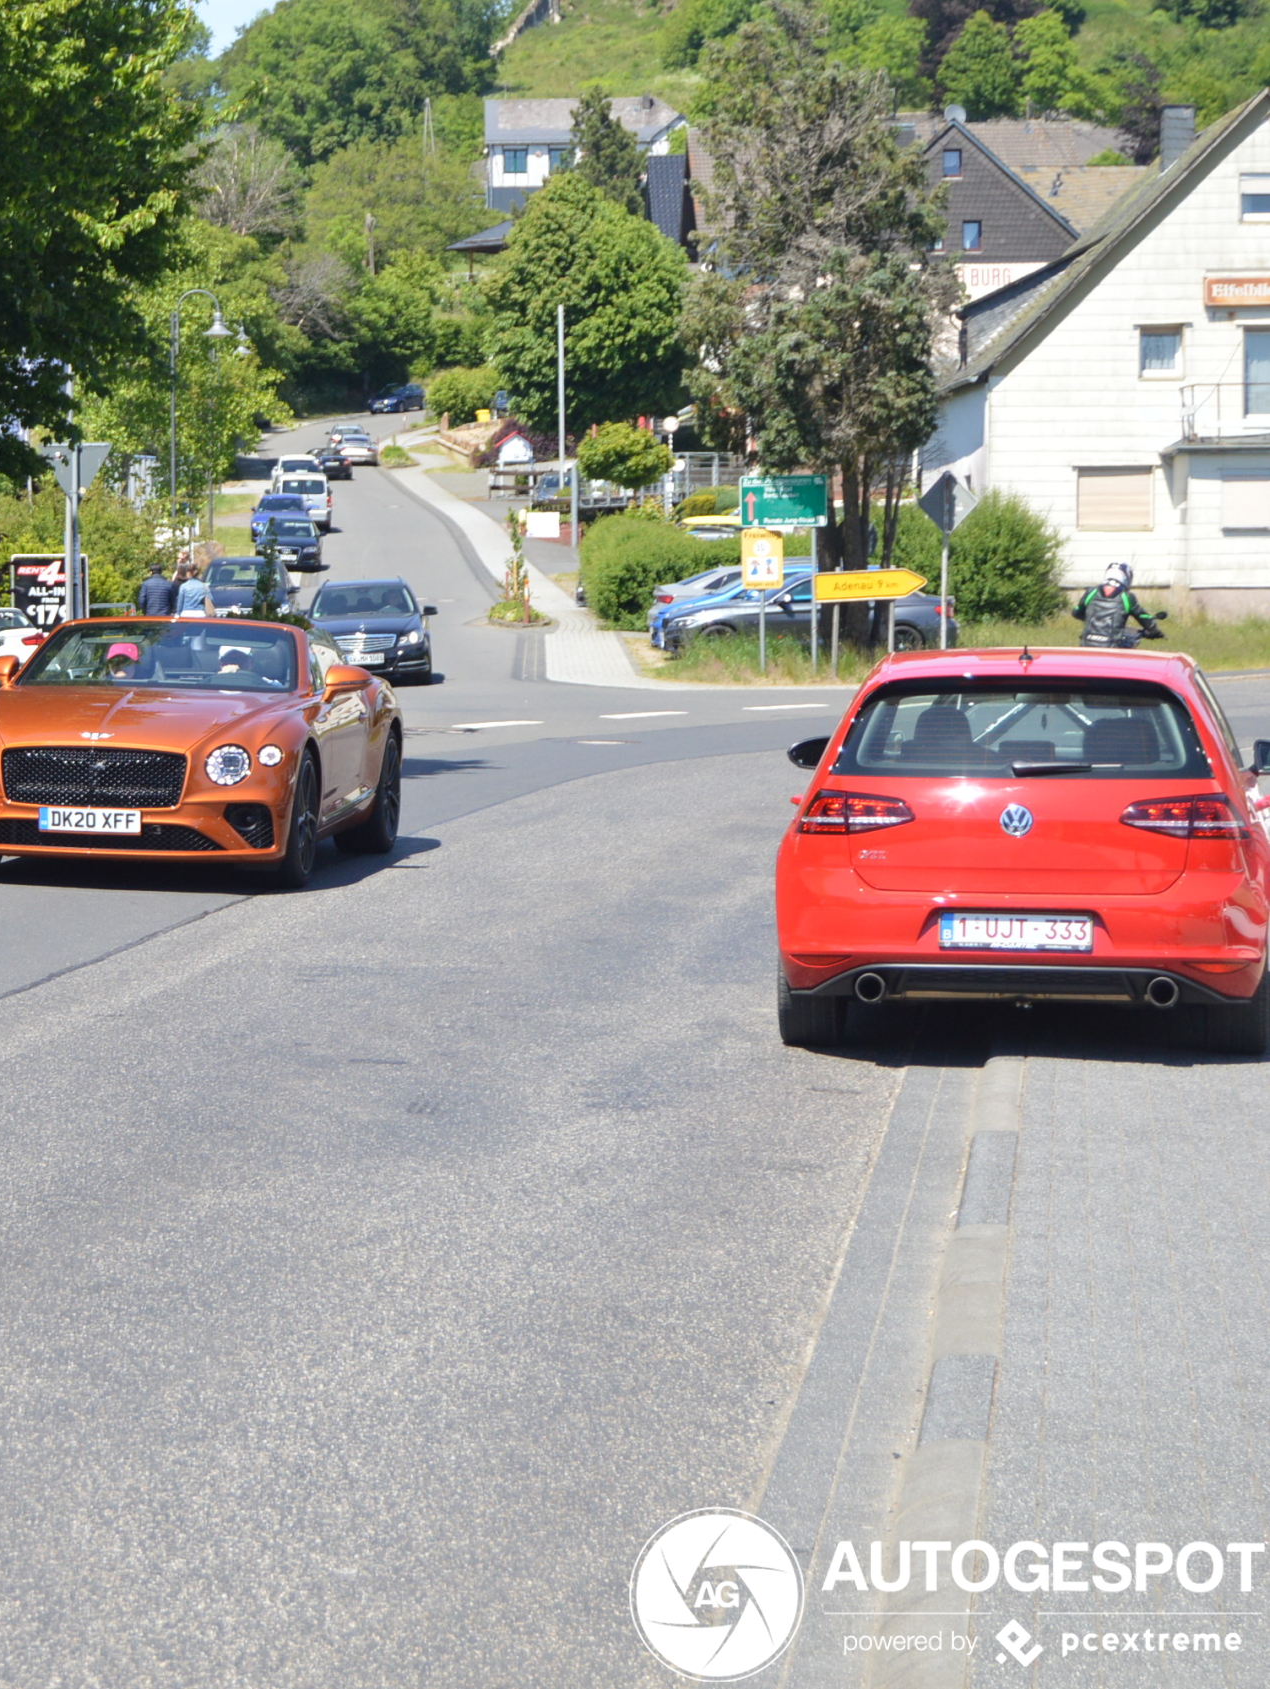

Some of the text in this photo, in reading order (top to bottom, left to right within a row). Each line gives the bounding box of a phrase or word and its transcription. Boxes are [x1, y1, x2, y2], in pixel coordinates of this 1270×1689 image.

[971, 267, 1011, 287] BURG
[1211, 283, 1270, 298] Eifelbli
[833, 580, 874, 592] Adenau
[877, 579, 884, 589] 9
[51, 810, 136, 830] DK20 XFF
[942, 929, 952, 939] B
